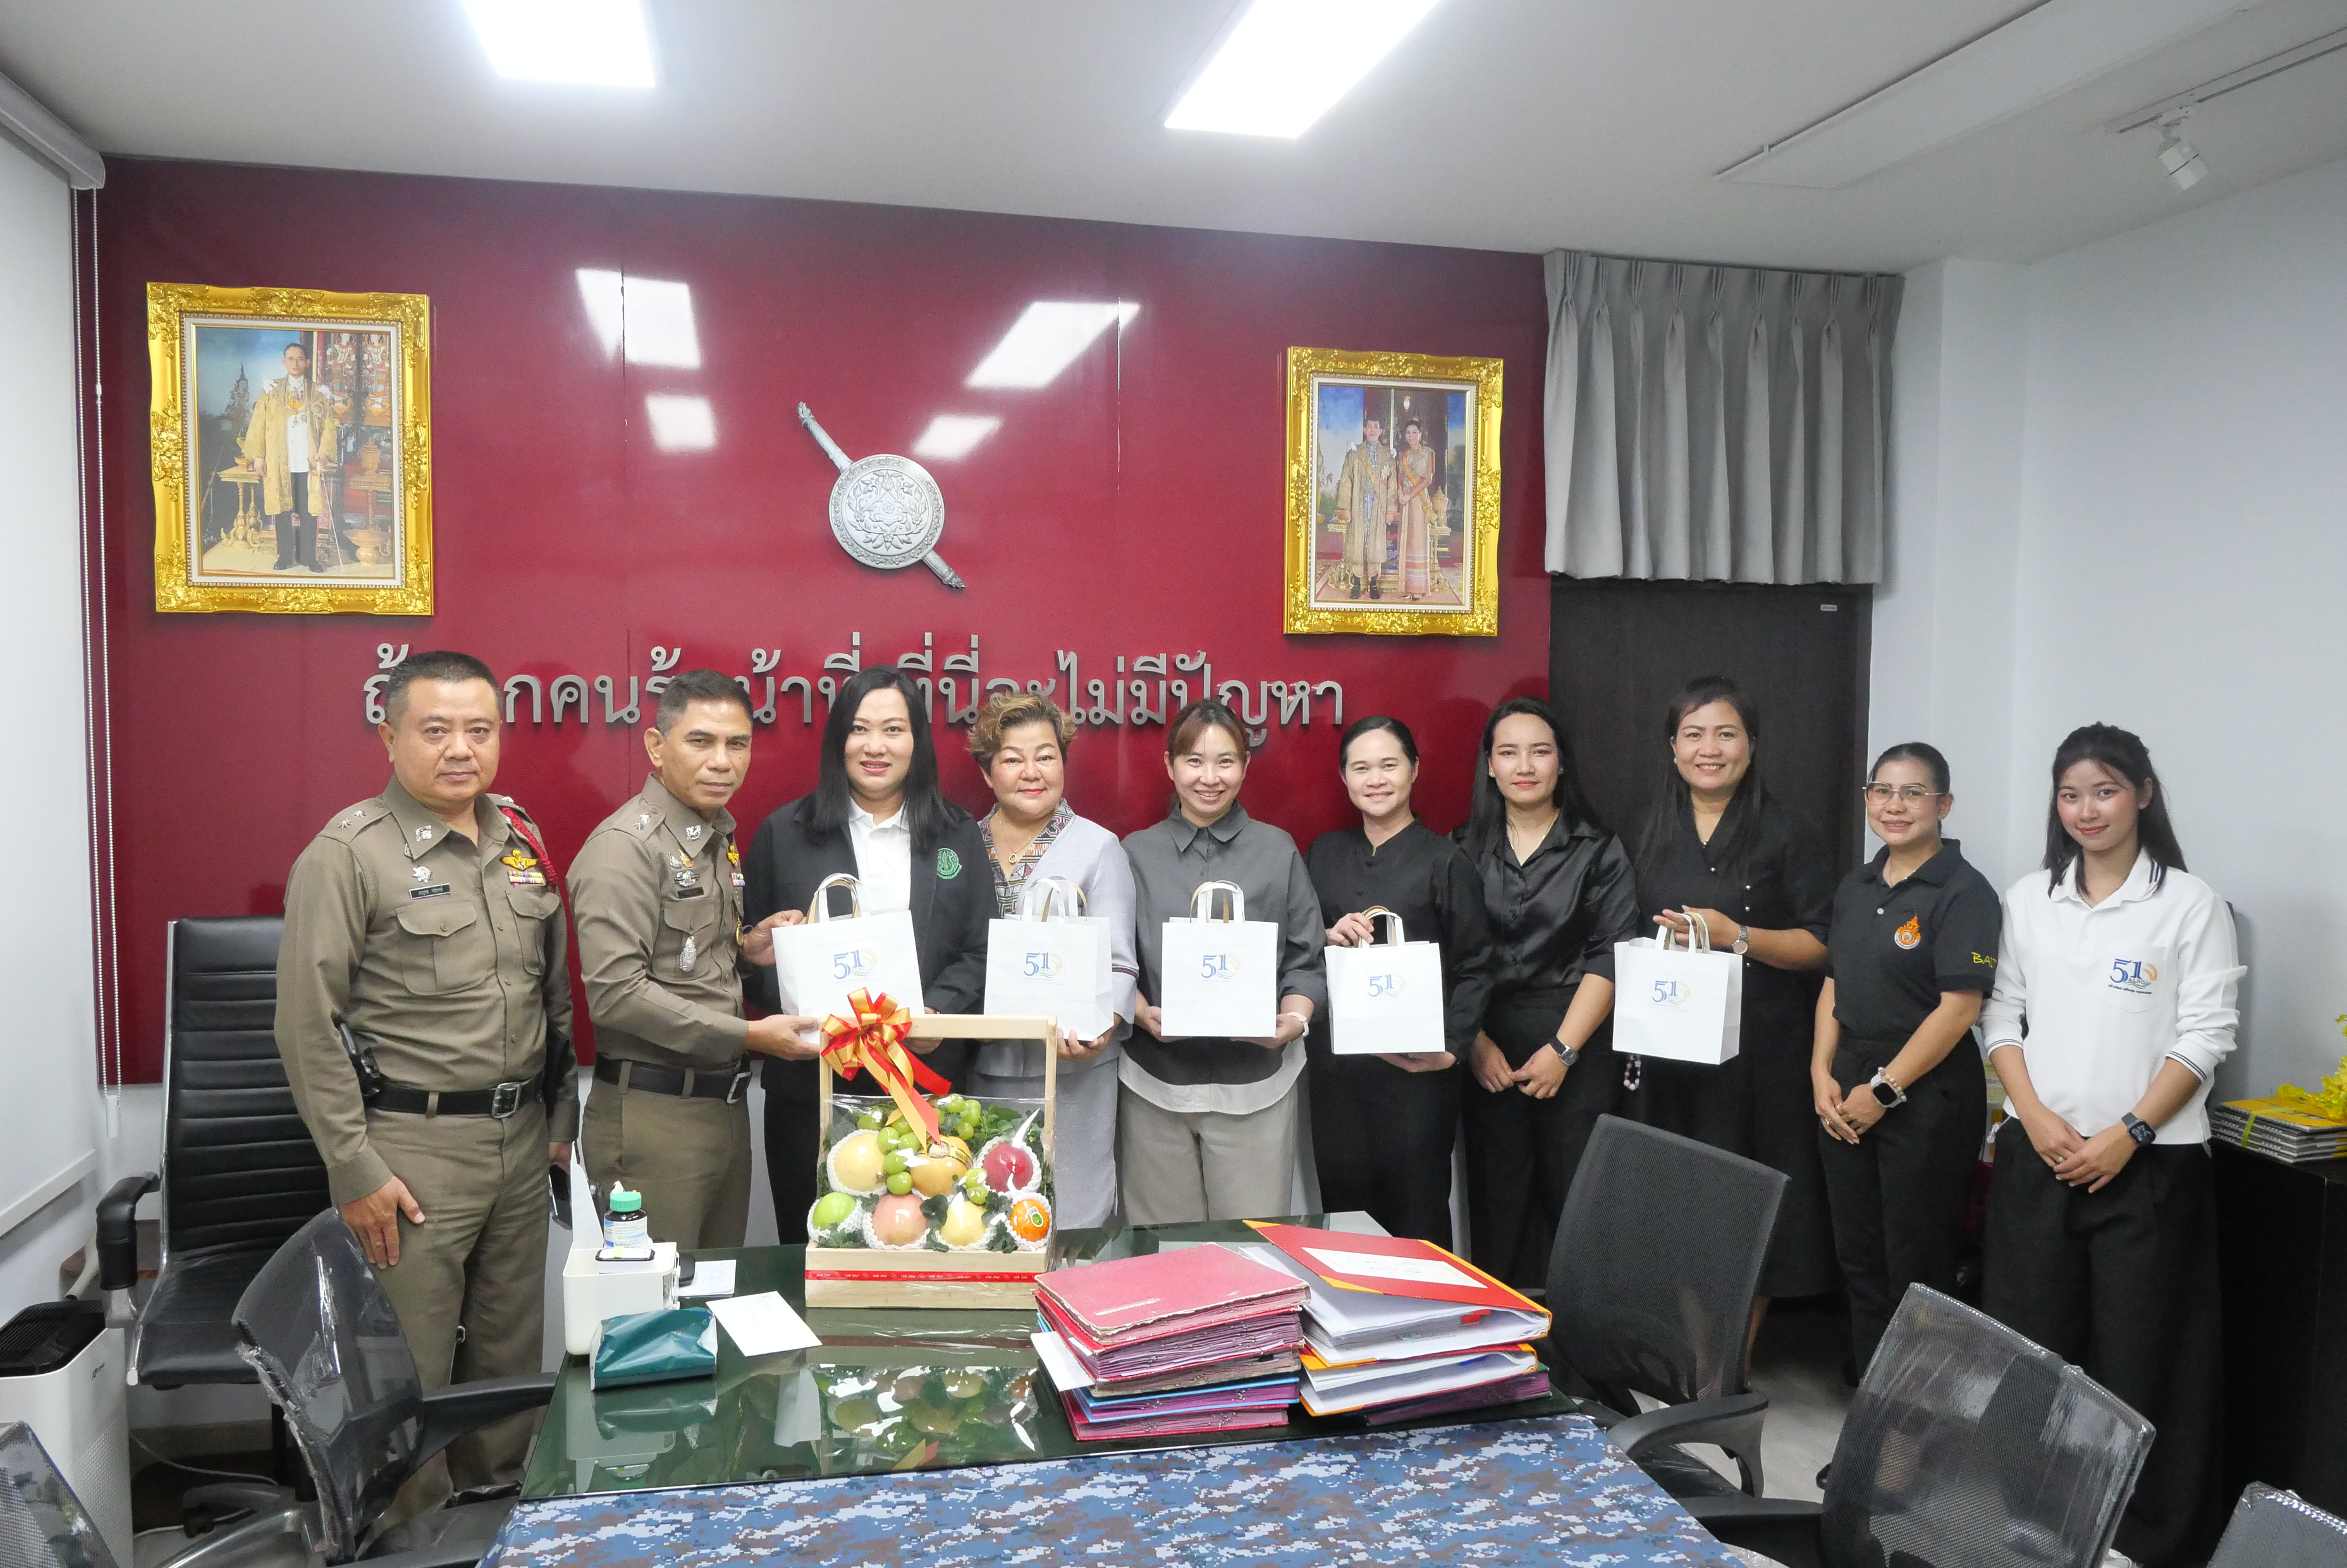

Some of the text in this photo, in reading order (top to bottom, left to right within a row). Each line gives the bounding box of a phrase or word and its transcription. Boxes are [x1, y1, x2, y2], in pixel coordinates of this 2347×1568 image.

[833, 949, 864, 979] 51
[1024, 952, 1050, 976] 51
[1201, 953, 1229, 978] 51
[2110, 959, 2142, 983] 51
[1368, 974, 1395, 997] 51
[1651, 980, 1678, 1003] 51
